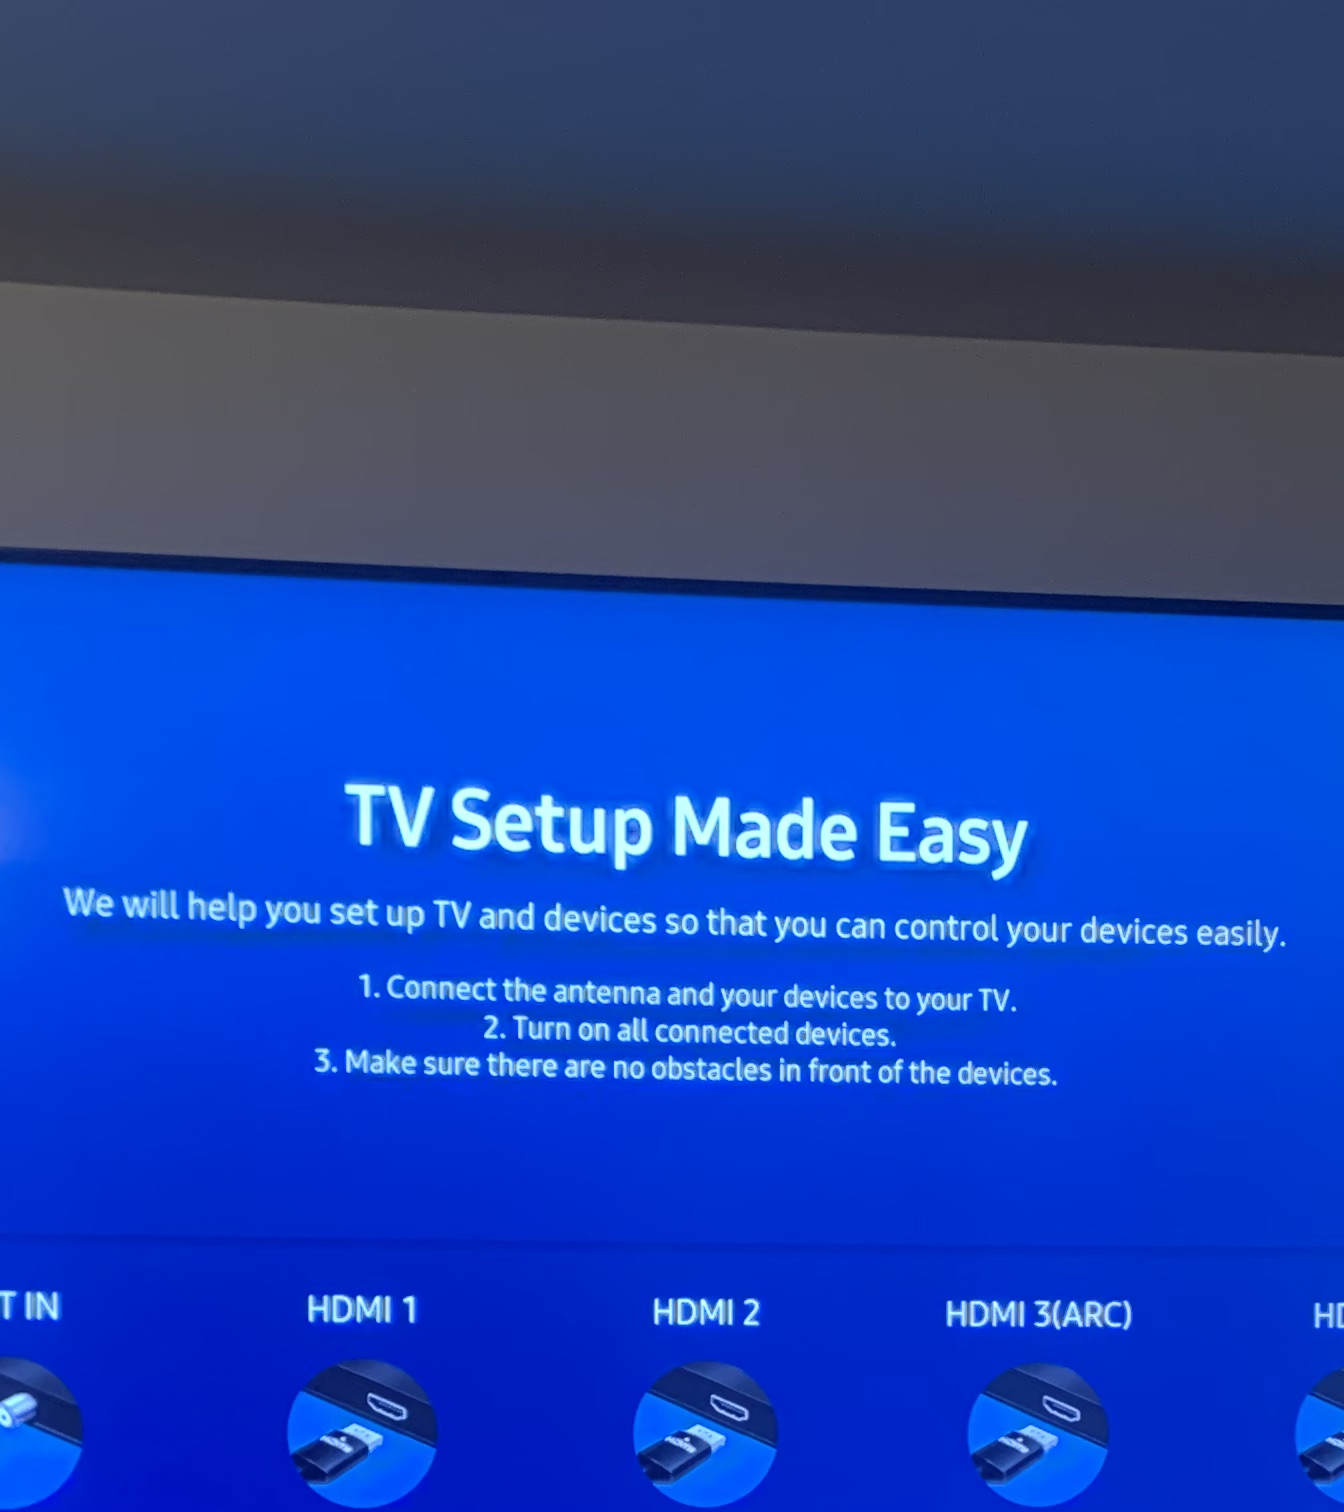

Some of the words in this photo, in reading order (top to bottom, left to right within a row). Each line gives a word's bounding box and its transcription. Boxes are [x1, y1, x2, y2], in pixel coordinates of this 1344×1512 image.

[345, 784, 435, 847] TV
[452, 787, 652, 870] Setup
[675, 796, 857, 861] Made
[880, 802, 1028, 880] Easy
[63, 887, 114, 917] We
[122, 890, 179, 919] will
[189, 891, 257, 929] help
[265, 901, 320, 928] you
[330, 899, 378, 926] set
[387, 905, 424, 934] up
[433, 900, 471, 928] TV
[480, 902, 534, 930] and
[544, 903, 656, 933] devices
[666, 913, 698, 934] so
[706, 908, 767, 936] that
[775, 916, 826, 943] you
[836, 918, 885, 939] can
[895, 914, 998, 941] control
[1007, 922, 1072, 948] your
[1081, 916, 1188, 945] devices
[1197, 919, 1285, 952] easily.
[359, 974, 380, 998] 1.
[387, 975, 498, 1002] Connect
[503, 977, 546, 1002] the
[554, 980, 660, 1005] antenna
[667, 982, 714, 1006] and
[721, 988, 778, 1012] your
[784, 984, 878, 1009] devices
[884, 988, 910, 1010] to
[917, 992, 972, 1015] your
[979, 988, 1016, 1011] TV.
[484, 1015, 505, 1039] 2.
[513, 1015, 570, 1040] Turn
[579, 1022, 609, 1041] on
[617, 1017, 649, 1042] all
[655, 1018, 788, 1044] connected
[796, 1021, 896, 1046] devices.
[315, 1048, 337, 1072] 3.
[346, 1049, 417, 1074] Make
[424, 1056, 480, 1076] sure
[487, 1052, 558, 1077] there
[565, 1059, 605, 1078] are
[614, 1061, 645, 1079] no
[652, 1056, 772, 1081] obstacles
[780, 1058, 800, 1081] in
[808, 1057, 874, 1083] front
[878, 1057, 904, 1083] of
[909, 1060, 951, 1084] the
[958, 1061, 1056, 1085] devices.
[26, 1292, 58, 1320] IN
[308, 1295, 391, 1323] HDMI
[403, 1296, 415, 1323] 1
[654, 1298, 733, 1325] HDMI
[744, 1299, 759, 1325] 2
[947, 1301, 1024, 1327] HDMI
[1035, 1300, 1131, 1330] 3(ARC)
